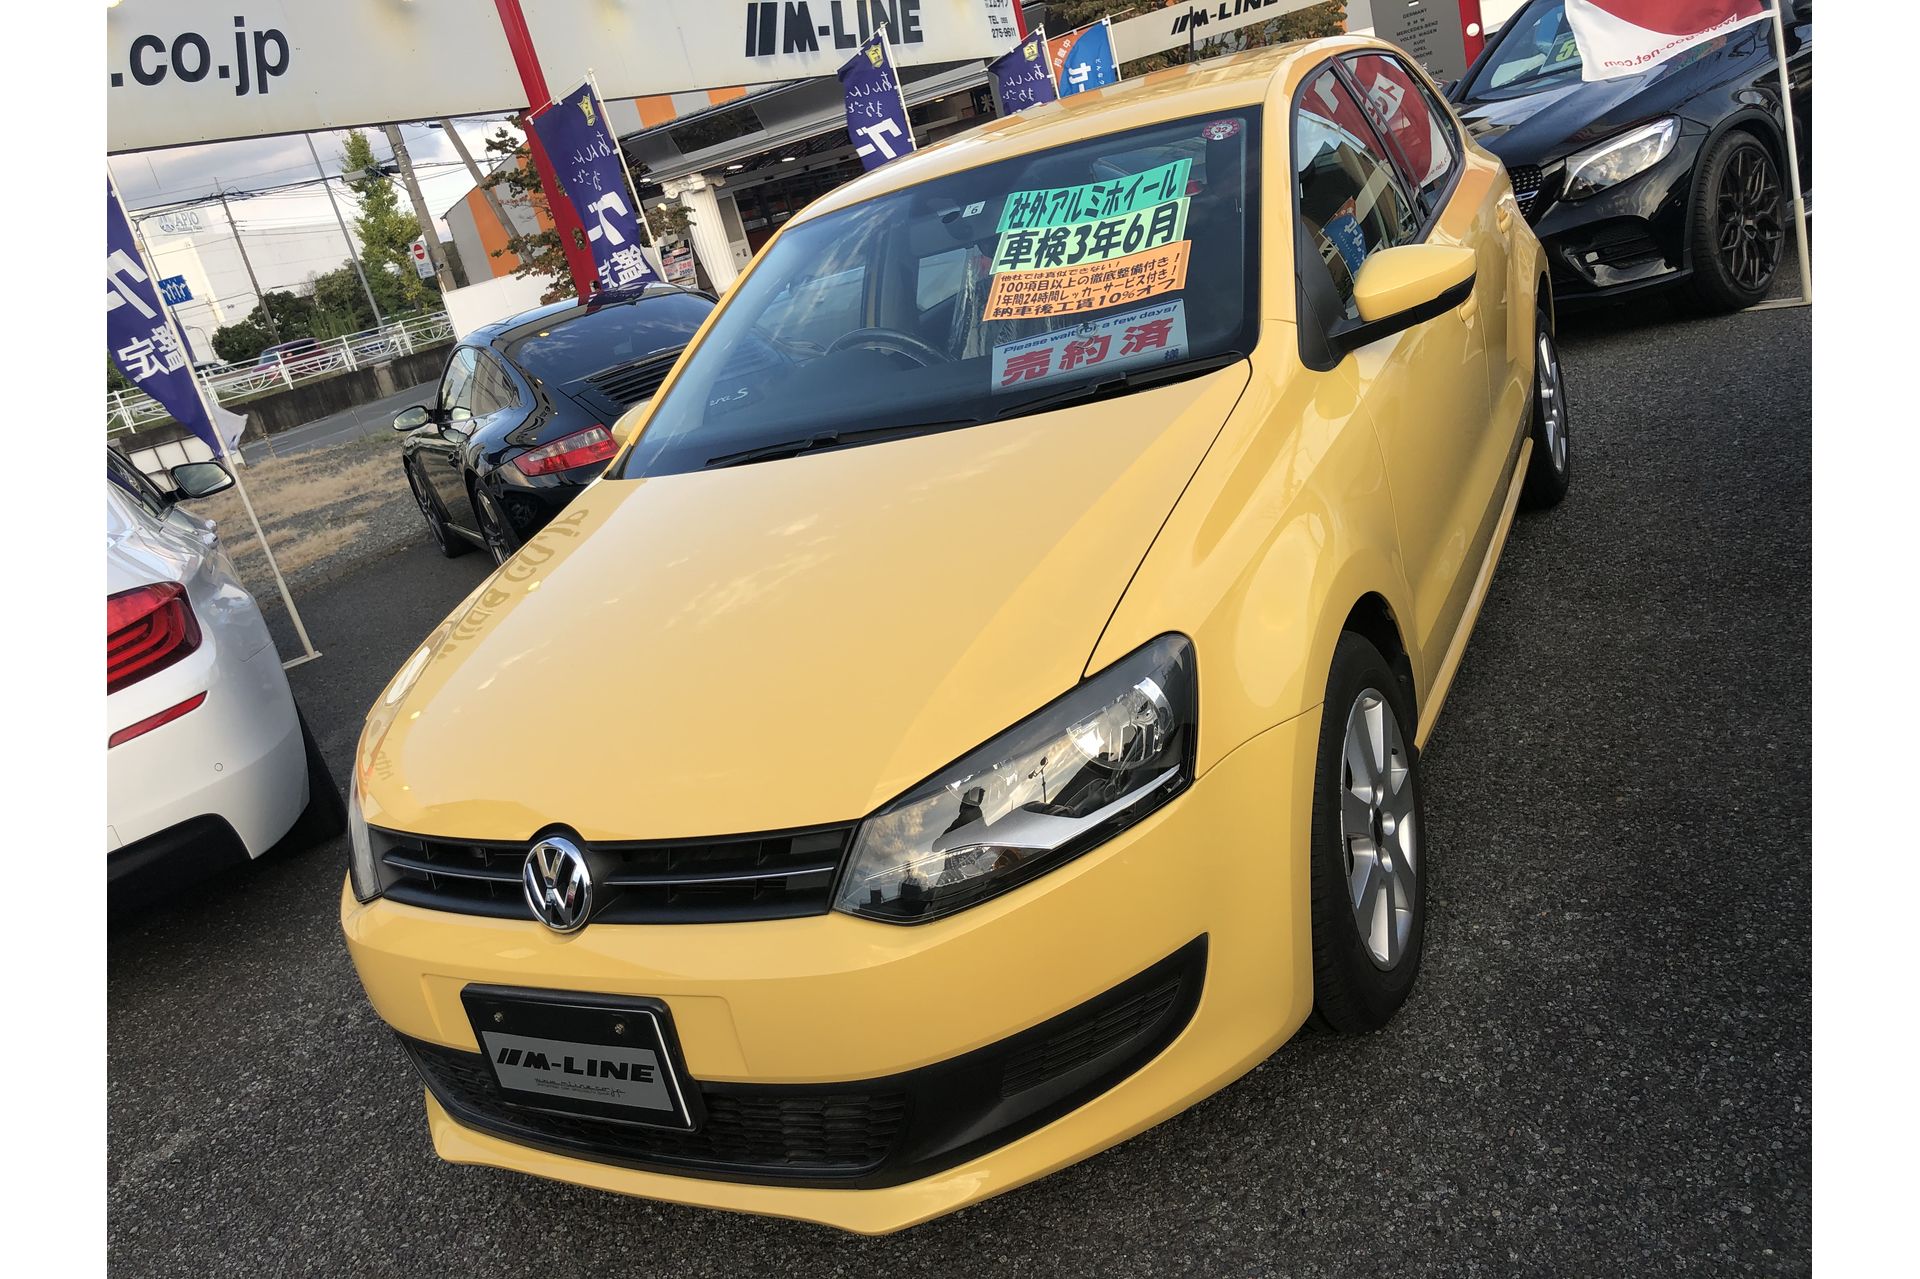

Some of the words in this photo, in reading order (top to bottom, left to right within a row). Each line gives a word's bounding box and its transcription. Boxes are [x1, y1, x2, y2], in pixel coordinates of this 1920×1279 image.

[988, 15, 999, 24] TEL
[111, 16, 290, 96] .co.jp
[1008, 163, 1178, 229] 社外アルミホイール
[999, 201, 1179, 270] 車検3年6月
[1001, 318, 1174, 387] 売約済
[1003, 338, 1048, 354] Please
[1050, 330, 1075, 342] wait
[1079, 324, 1099, 336] for
[1113, 315, 1137, 327] few
[1139, 305, 1177, 320] days!
[1163, 348, 1180, 362] 様
[523, 1050, 655, 1083] M-LINE
